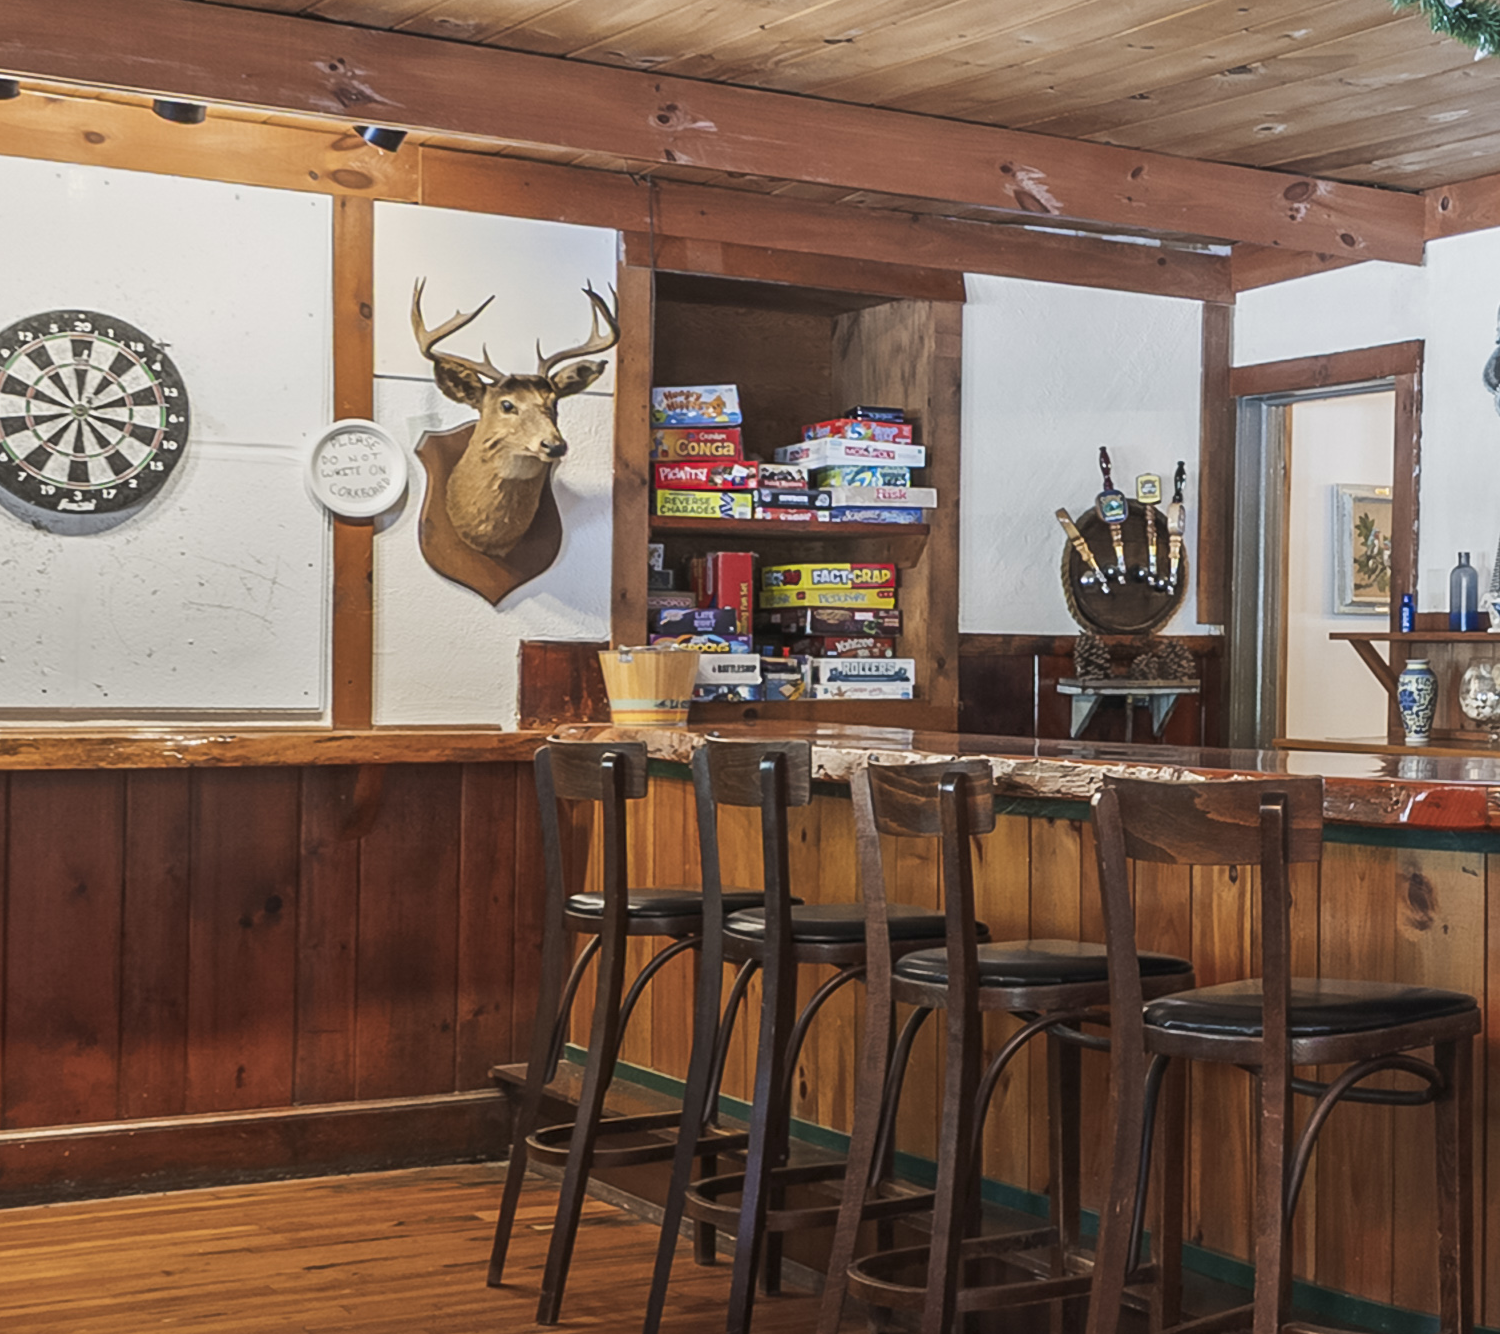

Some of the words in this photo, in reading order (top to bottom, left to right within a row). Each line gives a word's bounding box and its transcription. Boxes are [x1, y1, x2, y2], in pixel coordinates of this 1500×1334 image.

[49, 324, 59, 333] 5
[74, 322, 92, 332] 20
[18, 332, 33, 342] 12
[107, 329, 114, 338] 1
[130, 342, 144, 352] 18
[0, 348, 11, 358] 9
[164, 388, 179, 397] 13
[163, 440, 178, 450] 10
[329, 433, 381, 451] PLEASE
[321, 454, 339, 465] DO
[348, 452, 382, 462] NOT
[150, 462, 164, 471] 15
[321, 466, 361, 477] WRITE
[368, 464, 386, 476] ON
[18, 472, 27, 481] 7
[128, 479, 138, 488] 2
[329, 477, 391, 498] CORKBOARD
[40, 485, 56, 495] 19
[102, 489, 117, 499] 17
[876, 488, 907, 500] Risk
[74, 491, 83, 501] 3
[664, 497, 711, 506] REVERSE
[659, 505, 716, 515] CHARADES
[841, 662, 896, 675] ROLLERS
